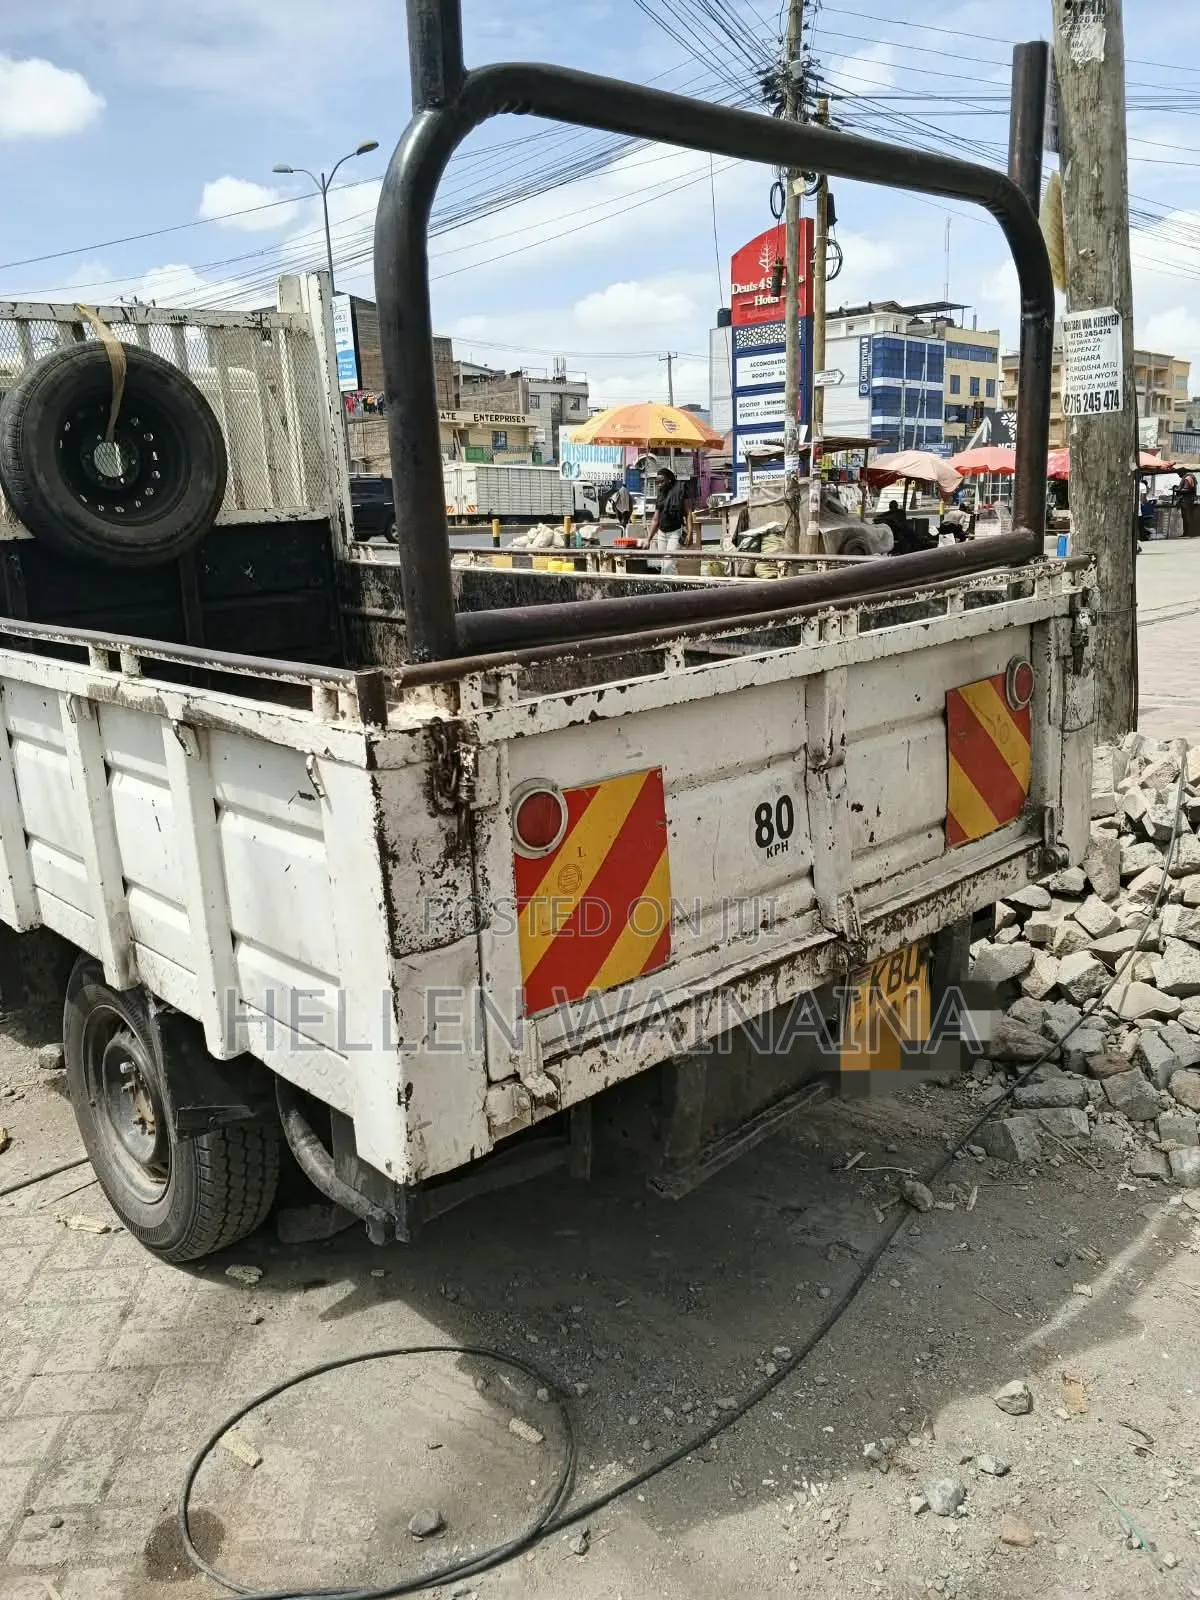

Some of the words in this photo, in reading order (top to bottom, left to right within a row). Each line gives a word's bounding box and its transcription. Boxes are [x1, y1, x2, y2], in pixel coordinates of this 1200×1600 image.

[758, 278, 765, 289] 4
[750, 359, 786, 367] ACCOMODATIO
[1095, 371, 1119, 380] NYOTA
[1083, 391, 1101, 413] 245
[1103, 389, 1120, 410] 474
[473, 413, 526, 423] ENTERPRISES
[755, 794, 795, 849] 80
[766, 839, 789, 859] KPH
